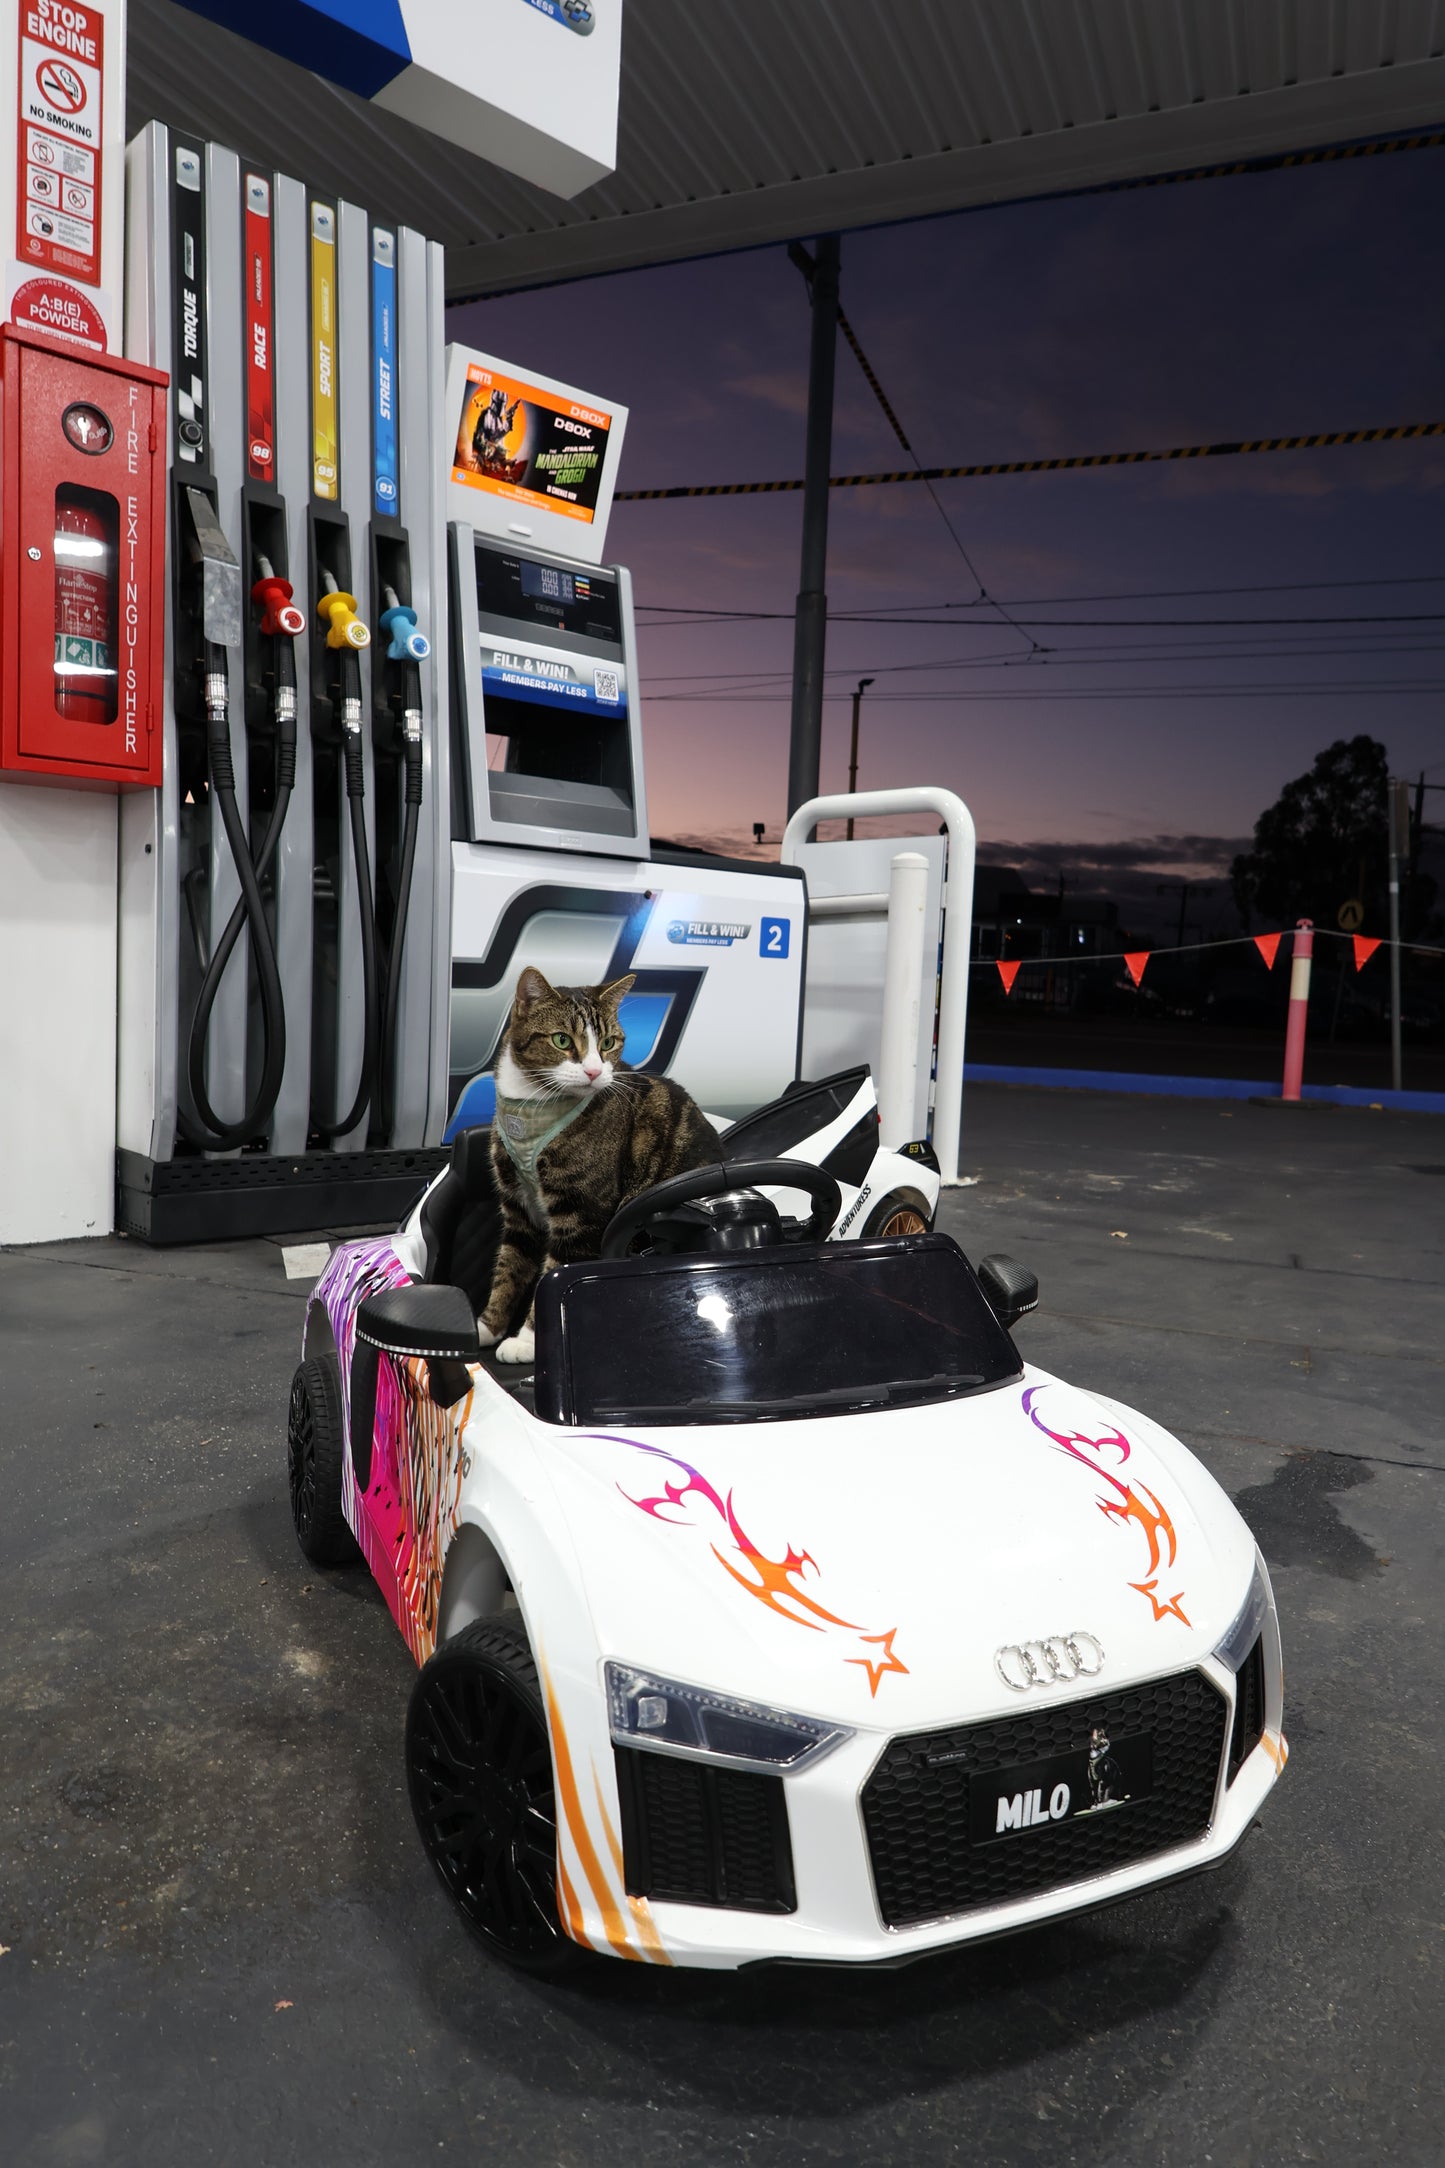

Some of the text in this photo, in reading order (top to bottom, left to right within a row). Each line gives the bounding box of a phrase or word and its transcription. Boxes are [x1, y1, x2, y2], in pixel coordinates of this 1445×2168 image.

[37, 0, 87, 33] STOP
[27, 11, 96, 61] ENGINE
[29, 104, 92, 139] NO SMOKING
[26, 279, 63, 290] COLOURED
[29, 303, 89, 335] POWDER
[40, 293, 81, 319] A:B(E)
[184, 288, 197, 358] TORQUE
[254, 322, 266, 370] RACE
[320, 340, 332, 398] SPORT
[379, 358, 391, 420] STREET
[127, 387, 138, 475] FIRE
[252, 445, 270, 459] 98
[535, 453, 599, 469] MANDALORIAN
[318, 465, 334, 477] 95
[555, 468, 586, 485] GROGU
[379, 483, 392, 495] 91
[125, 496, 138, 754] EXTINGUISHER
[493, 652, 569, 680] FILL & WIN!
[501, 673, 587, 698] MEMBERS PAY LESS
[688, 923, 745, 937] FILL & WIN!
[767, 925, 782, 951] 2
[996, 1783, 1071, 1833] MILO
